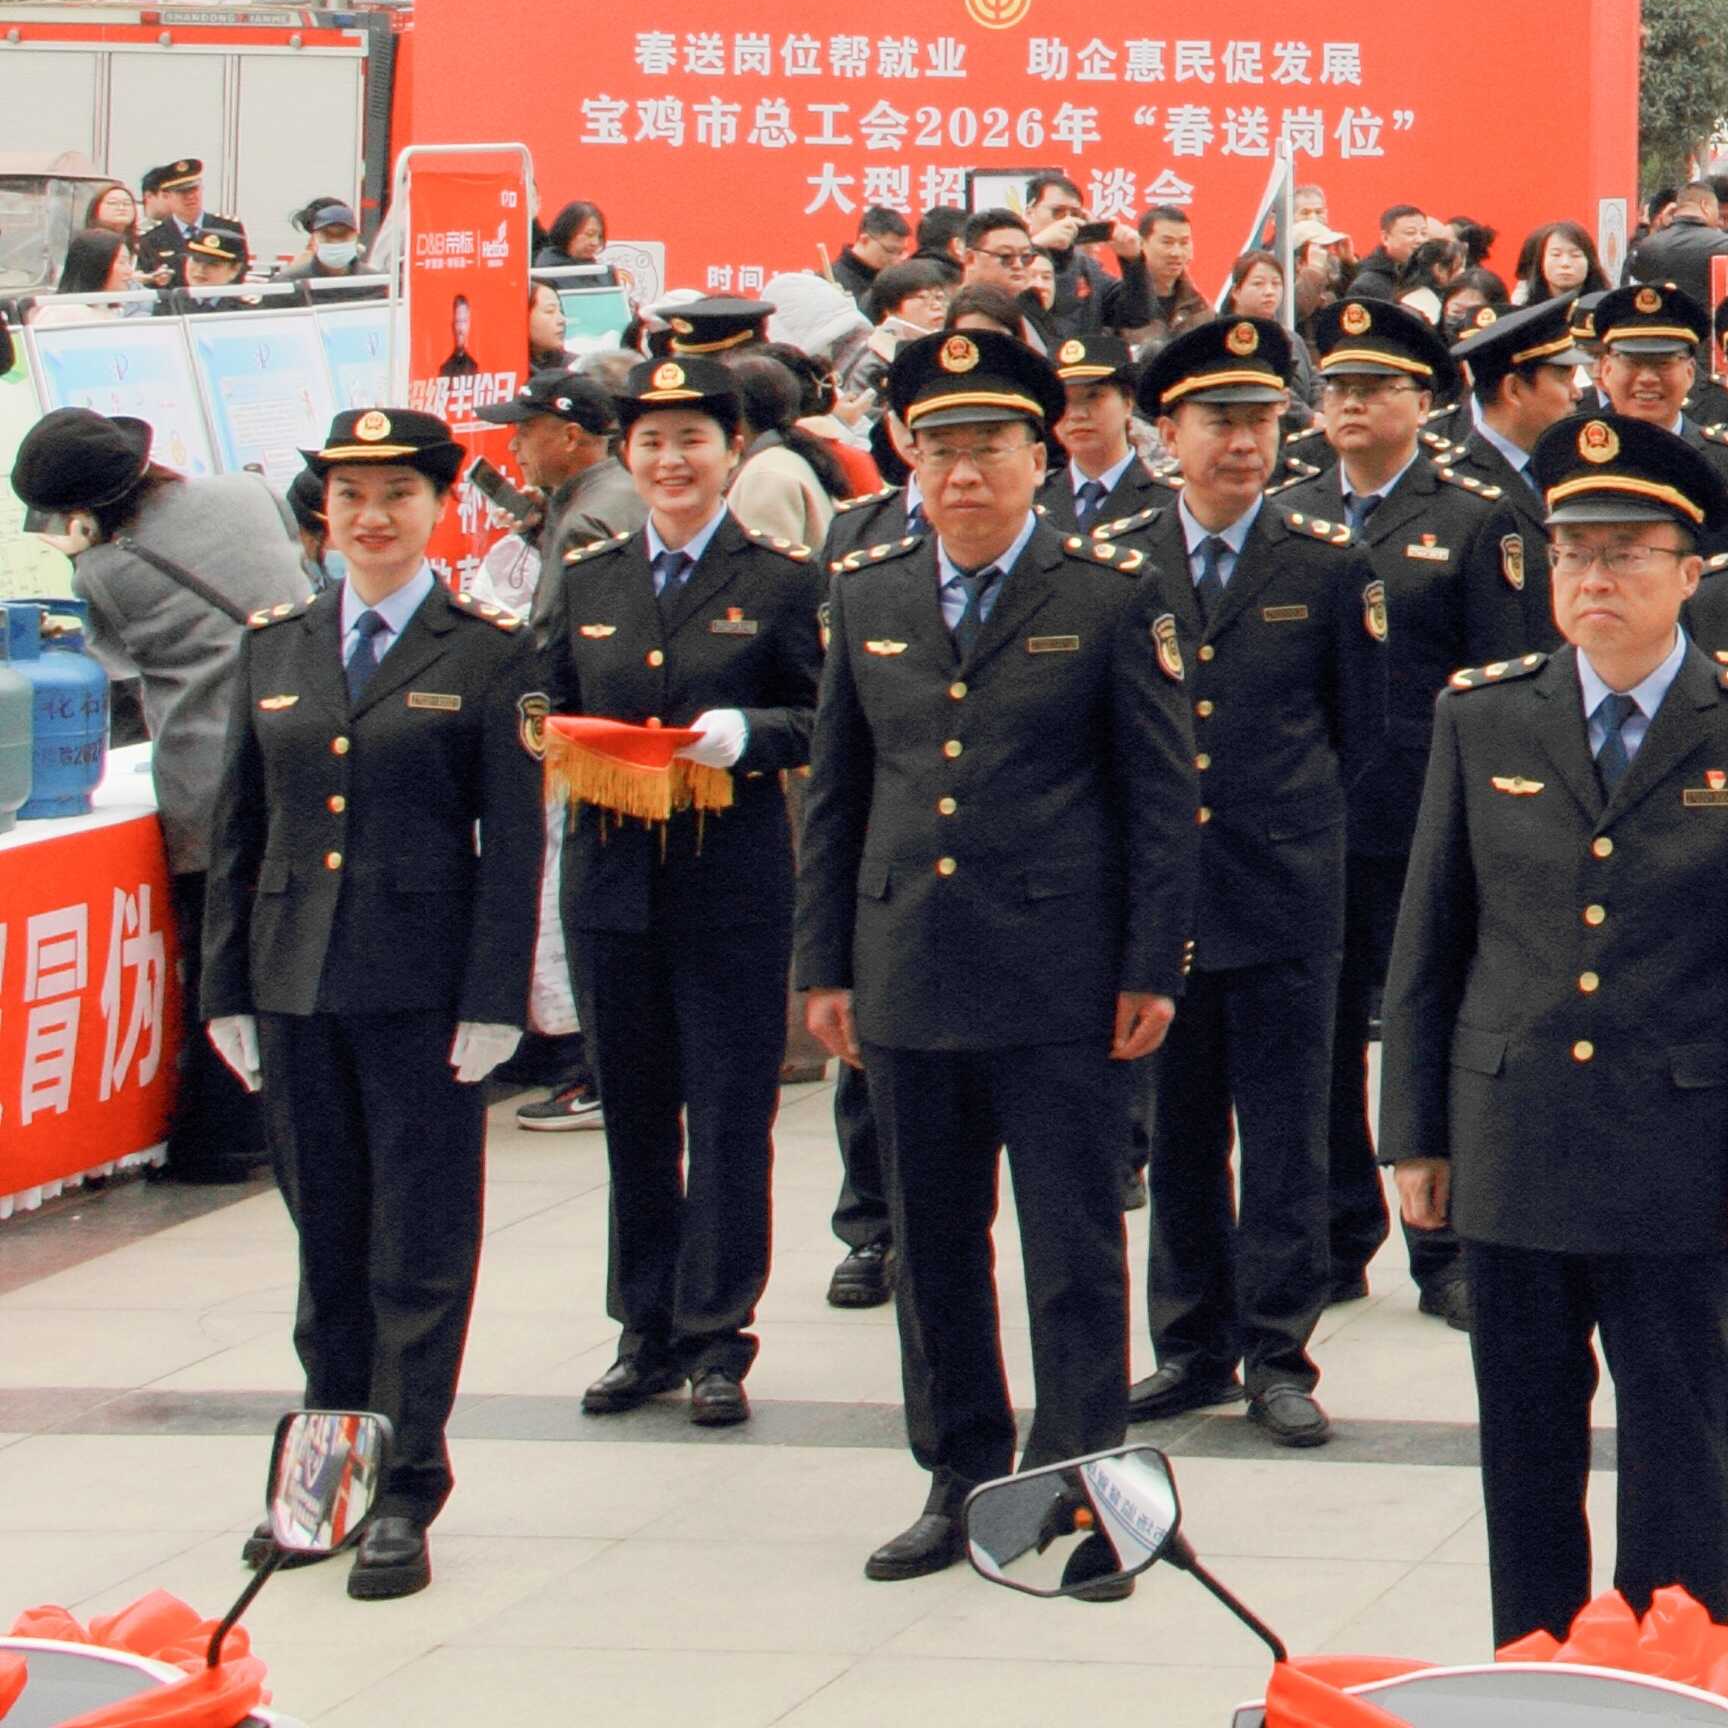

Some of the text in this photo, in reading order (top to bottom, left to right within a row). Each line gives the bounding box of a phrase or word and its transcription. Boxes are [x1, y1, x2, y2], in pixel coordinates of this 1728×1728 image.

[635, 31, 1364, 86] 春送岗位帮就业 助企惠民促发展
[805, 163, 1195, 221] 大型招谈会
[0, 883, 167, 1128] 冒伪
